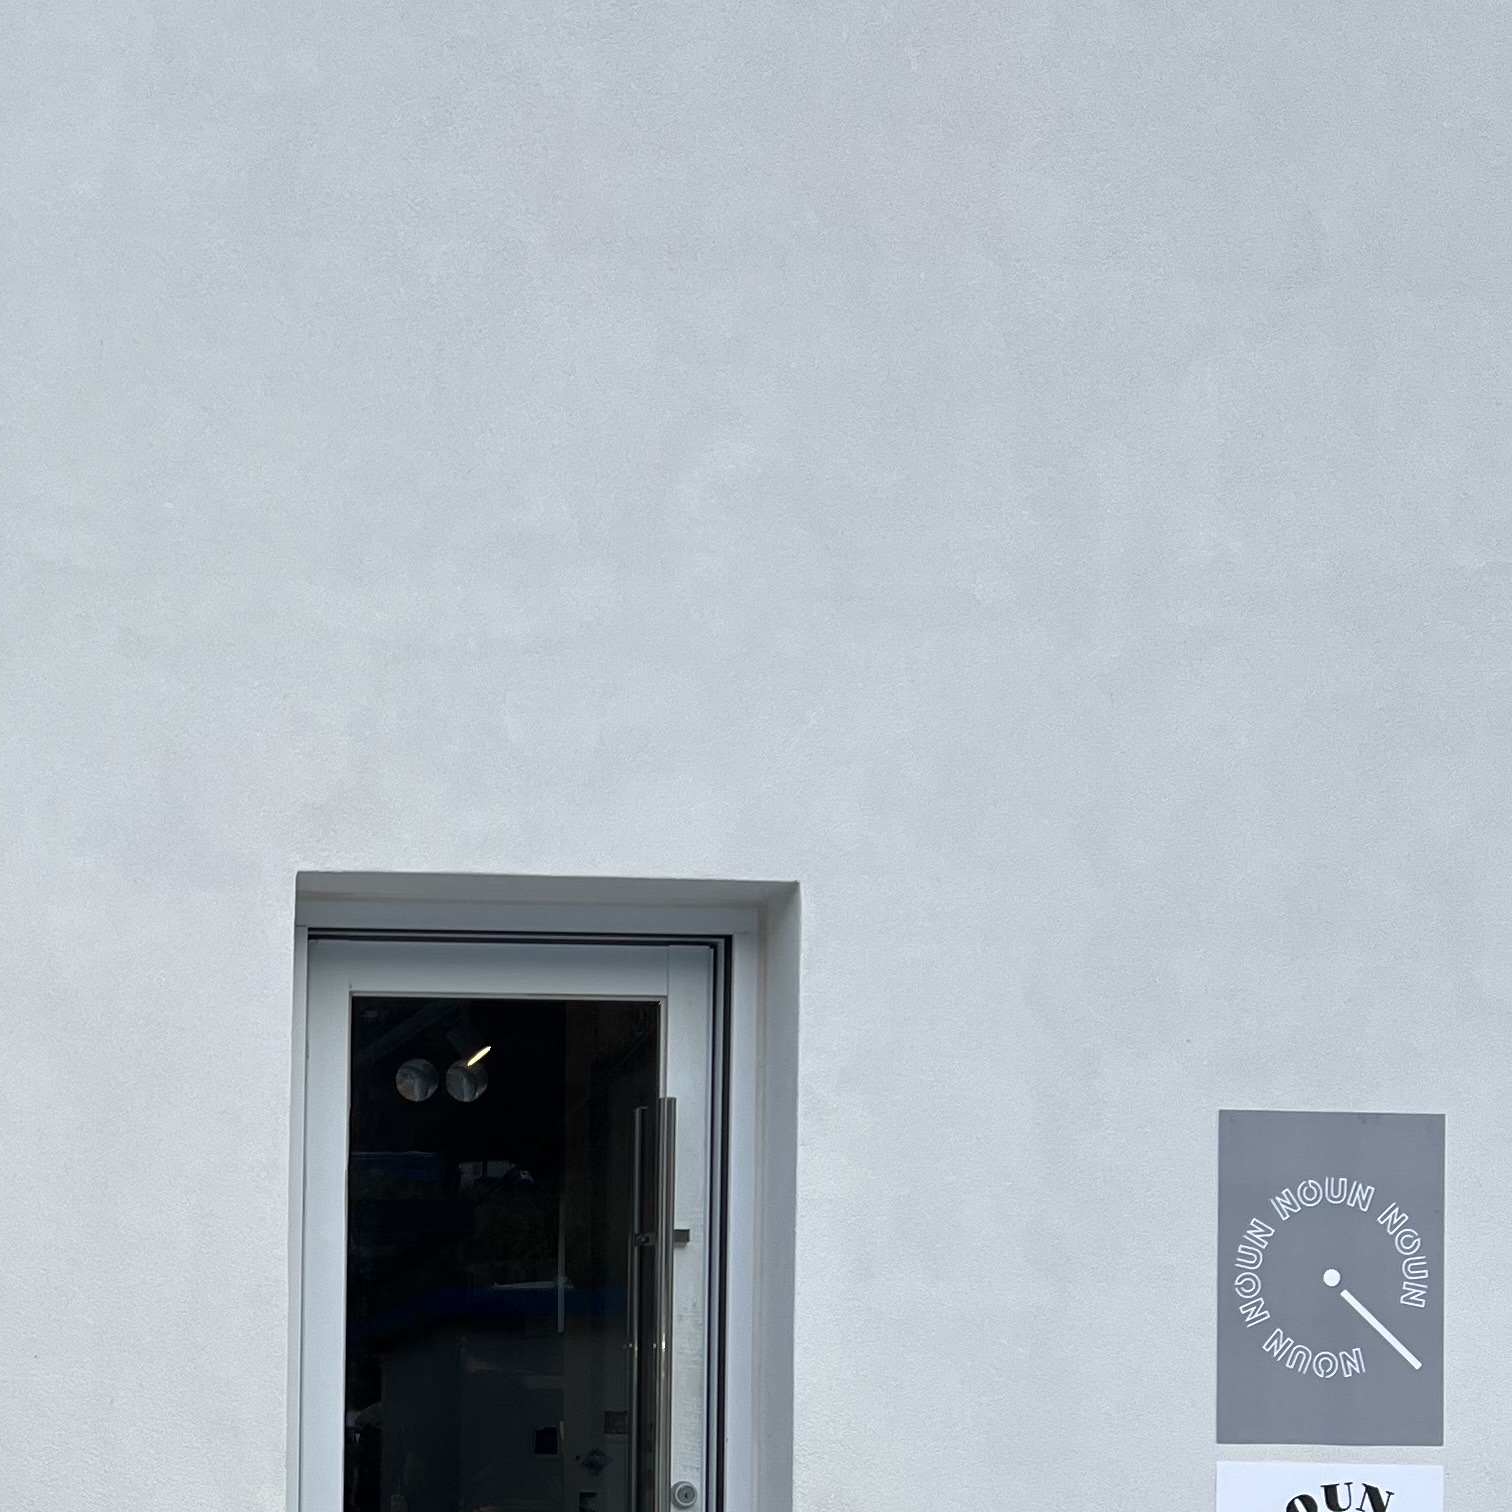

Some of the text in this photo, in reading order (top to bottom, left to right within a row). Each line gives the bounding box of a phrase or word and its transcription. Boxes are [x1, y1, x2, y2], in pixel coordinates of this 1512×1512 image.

[1270, 1176, 1375, 1221] NOUN
[1234, 1218, 1275, 1328] NOUN
[1377, 1202, 1428, 1308] NOUN
[1262, 1328, 1366, 1378] NOUN
